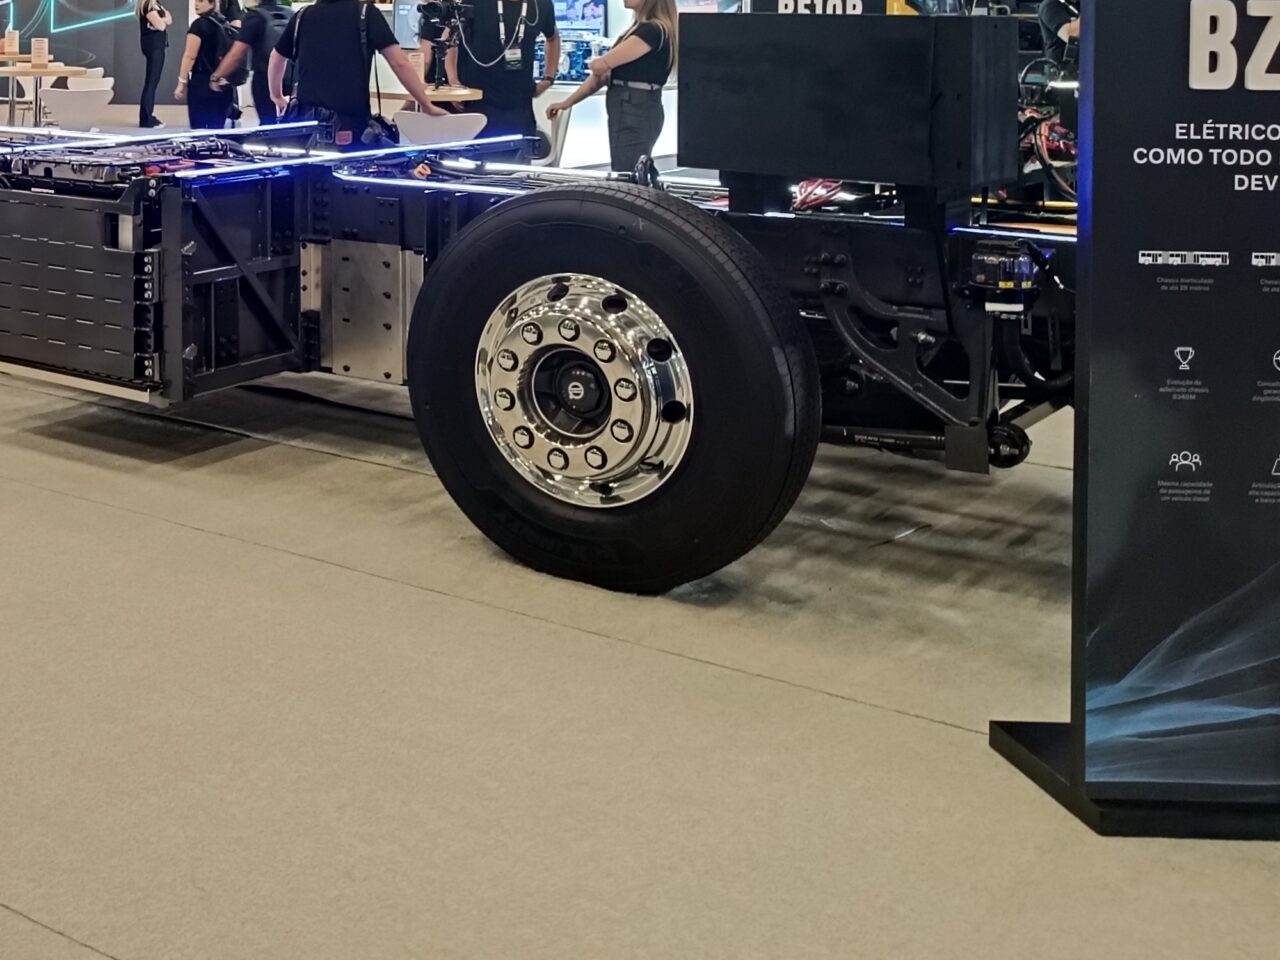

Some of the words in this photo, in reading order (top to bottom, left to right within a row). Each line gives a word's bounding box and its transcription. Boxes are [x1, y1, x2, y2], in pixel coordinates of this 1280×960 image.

[1175, 119, 1280, 141] ELÉTRICO
[1133, 147, 1203, 165] COMO
[1209, 148, 1272, 166] TODO
[1234, 174, 1279, 191] DEV
